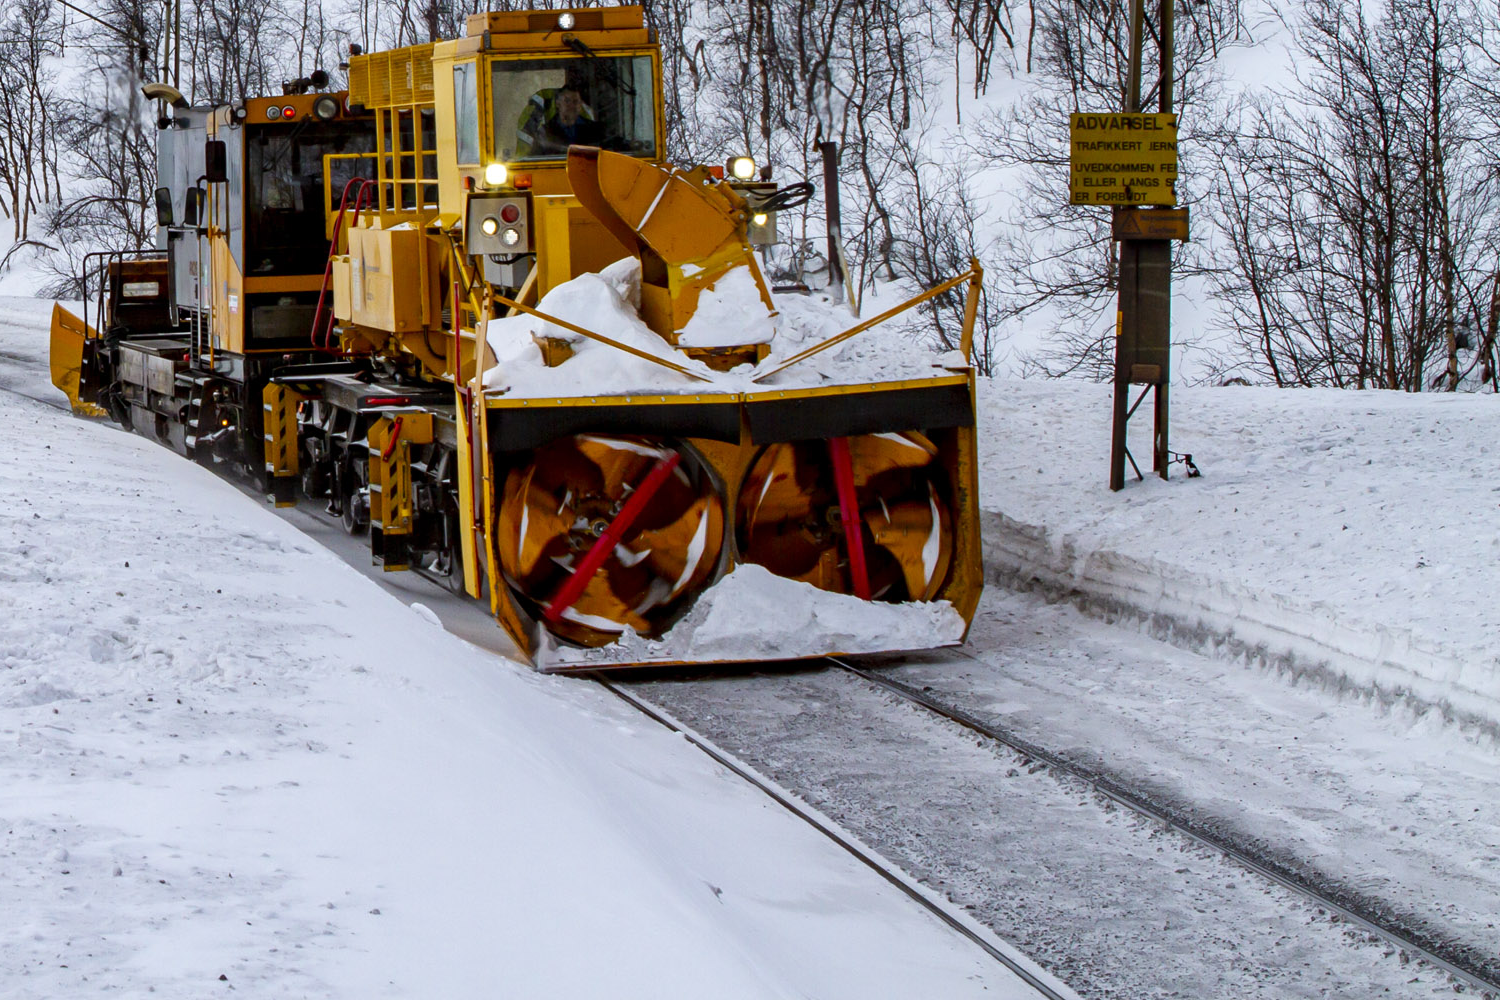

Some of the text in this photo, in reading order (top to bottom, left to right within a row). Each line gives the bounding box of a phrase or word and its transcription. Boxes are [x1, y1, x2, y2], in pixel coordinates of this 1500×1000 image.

[1076, 117, 1163, 130] ADVARSEL
[1075, 141, 1177, 151] TRAFIKKERT JERN
[1075, 163, 1155, 173] UVEDKOMMEN
[1083, 178, 1117, 187] ELLER
[1122, 178, 1160, 187] LANGS
[1075, 192, 1089, 201] ER
